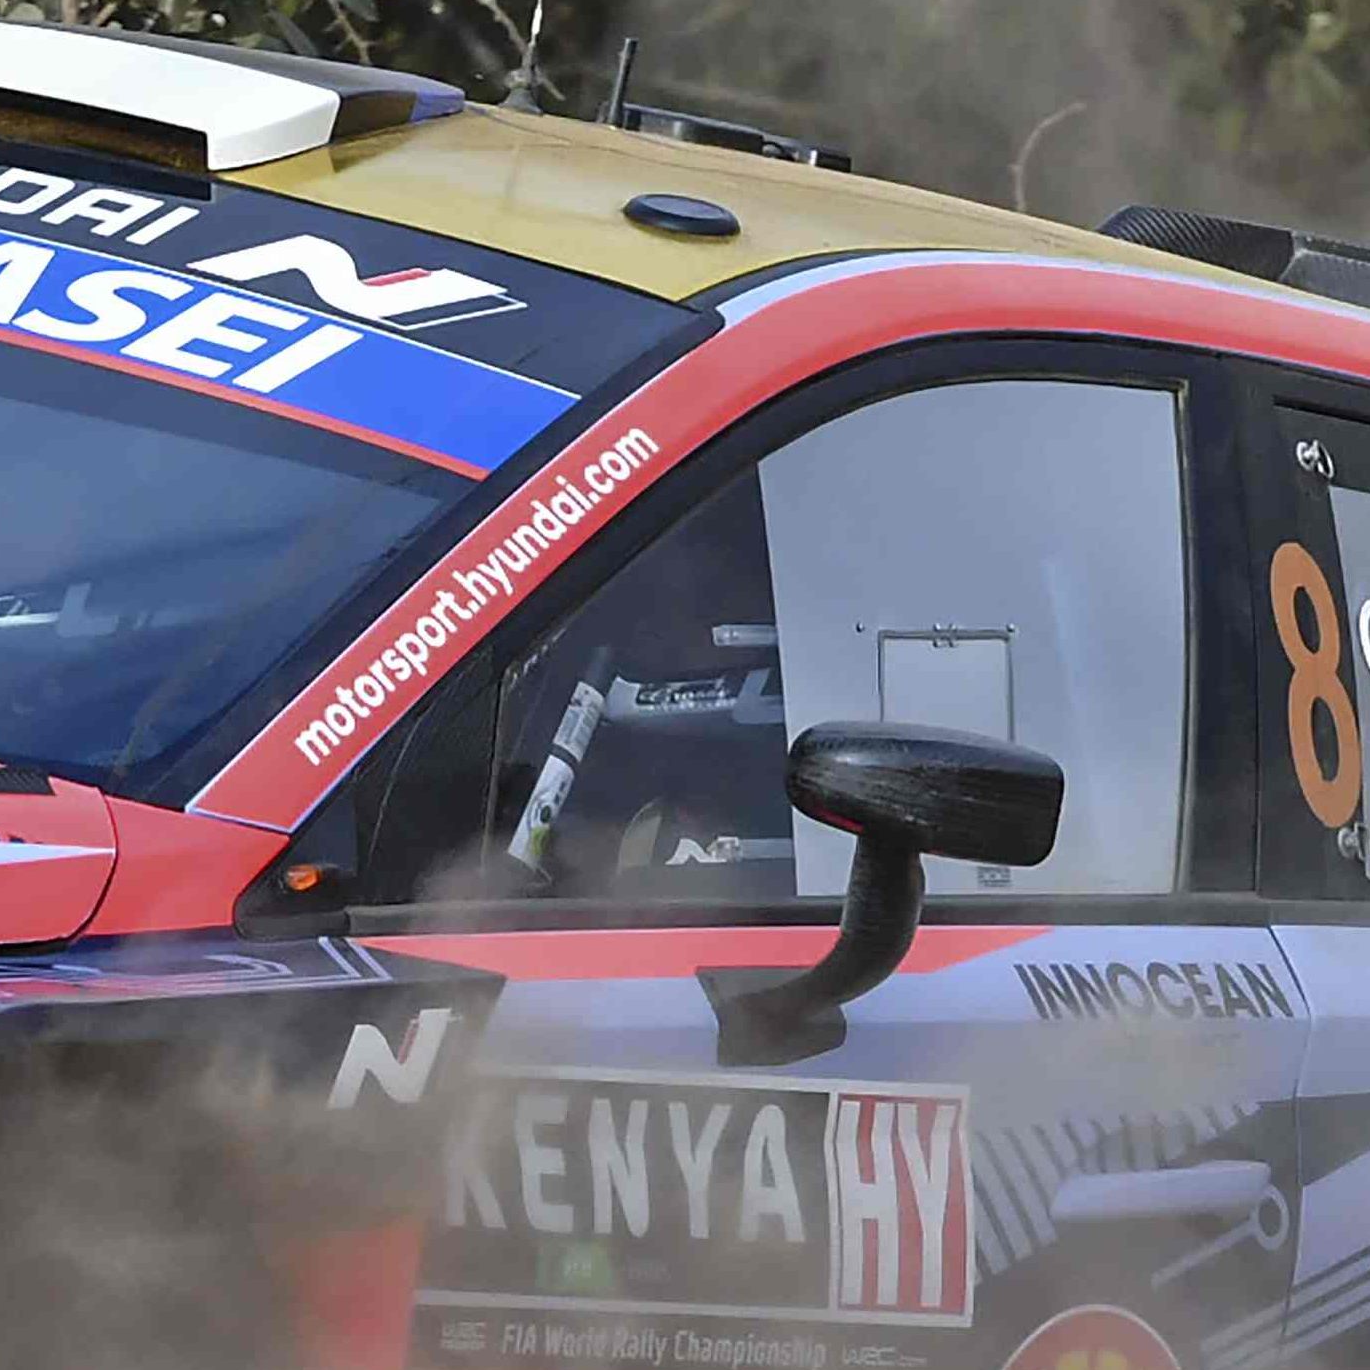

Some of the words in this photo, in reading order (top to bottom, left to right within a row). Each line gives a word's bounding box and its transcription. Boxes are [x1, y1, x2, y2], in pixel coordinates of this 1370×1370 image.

[294, 427, 660, 766] motorsport.hyundai.com
[1270, 542, 1361, 828] 8
[1013, 962, 1295, 1020] INNOCEAN
[444, 1094, 806, 1243] KENYA
[502, 1323, 537, 1356] FIA
[545, 1324, 608, 1359] World
[613, 1328, 667, 1366] Rally
